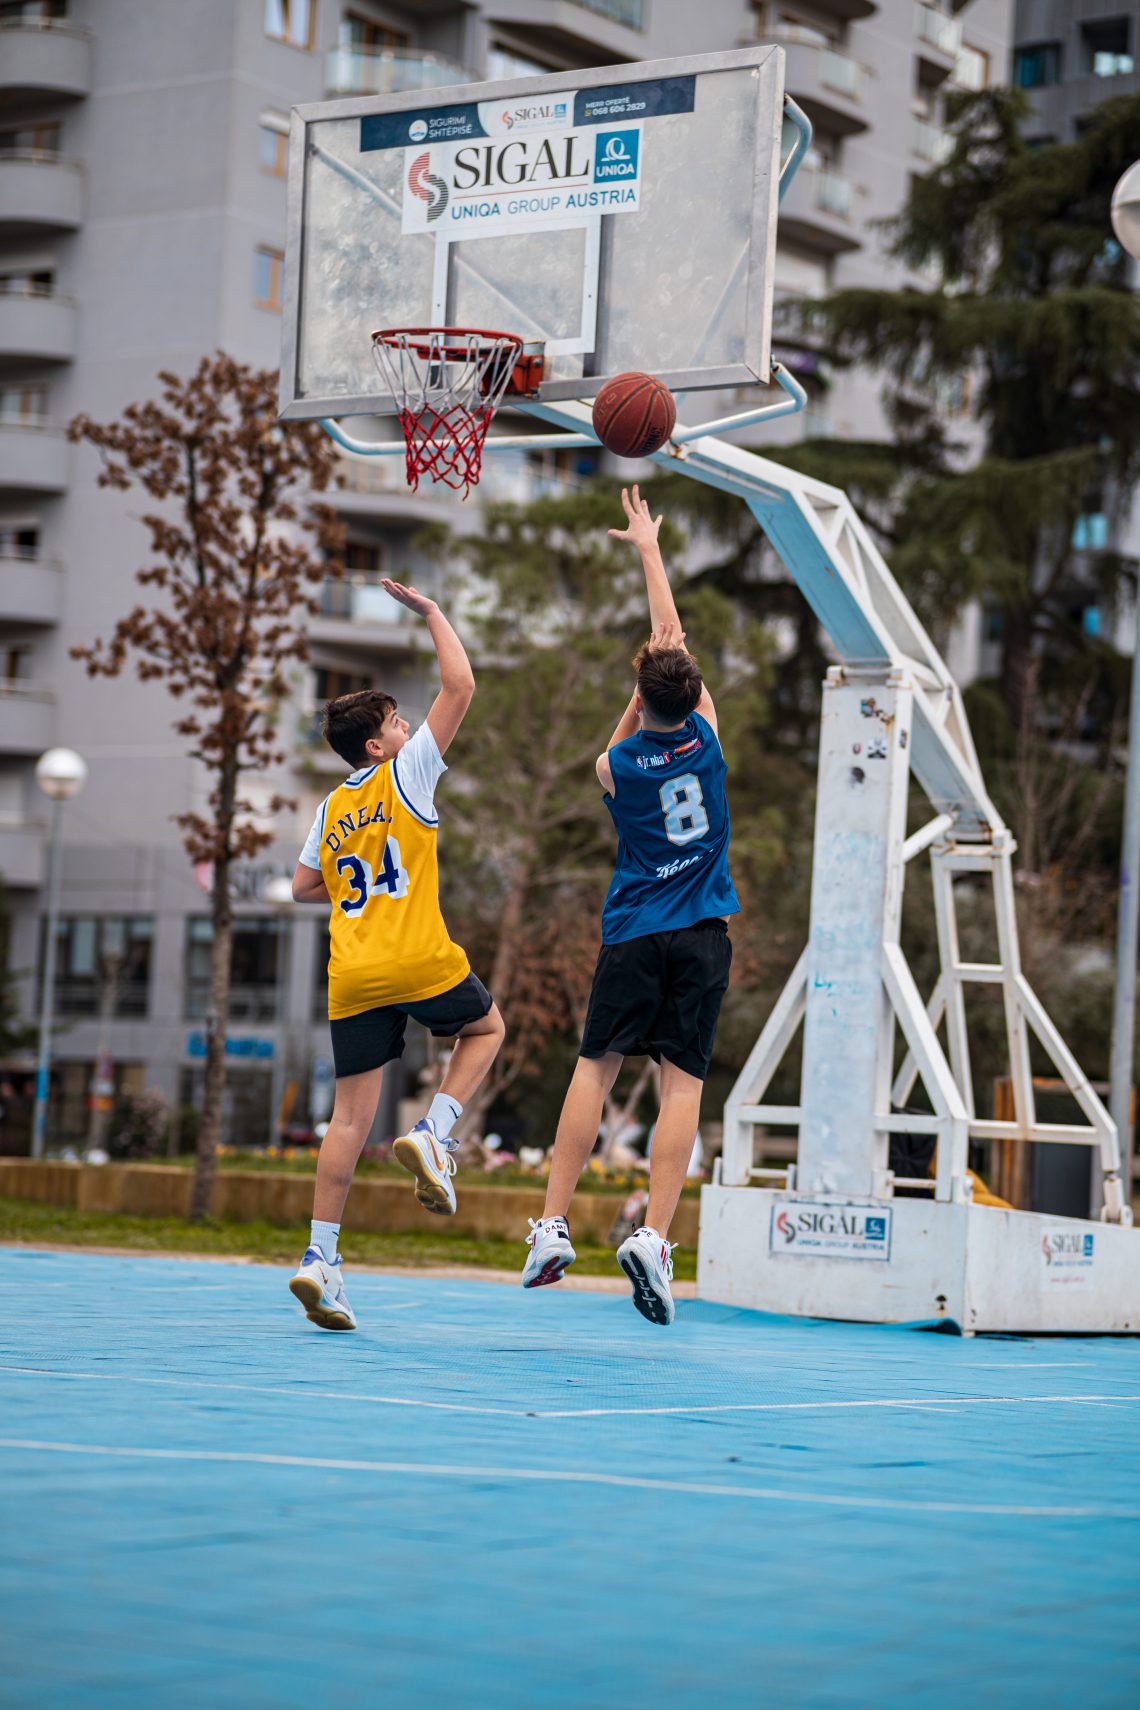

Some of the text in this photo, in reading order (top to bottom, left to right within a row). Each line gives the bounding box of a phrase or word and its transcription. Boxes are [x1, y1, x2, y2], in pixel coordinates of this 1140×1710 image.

[429, 116, 467, 128] SIGURIMI
[514, 106, 553, 122] SIGAL
[453, 136, 590, 190] SIGAL
[596, 163, 635, 177] UNIQA
[451, 188, 636, 220] UNIQA GROUP AUSTRIA
[659, 773, 709, 846] 8
[336, 837, 409, 917] 34
[797, 1212, 864, 1236] SIGAL
